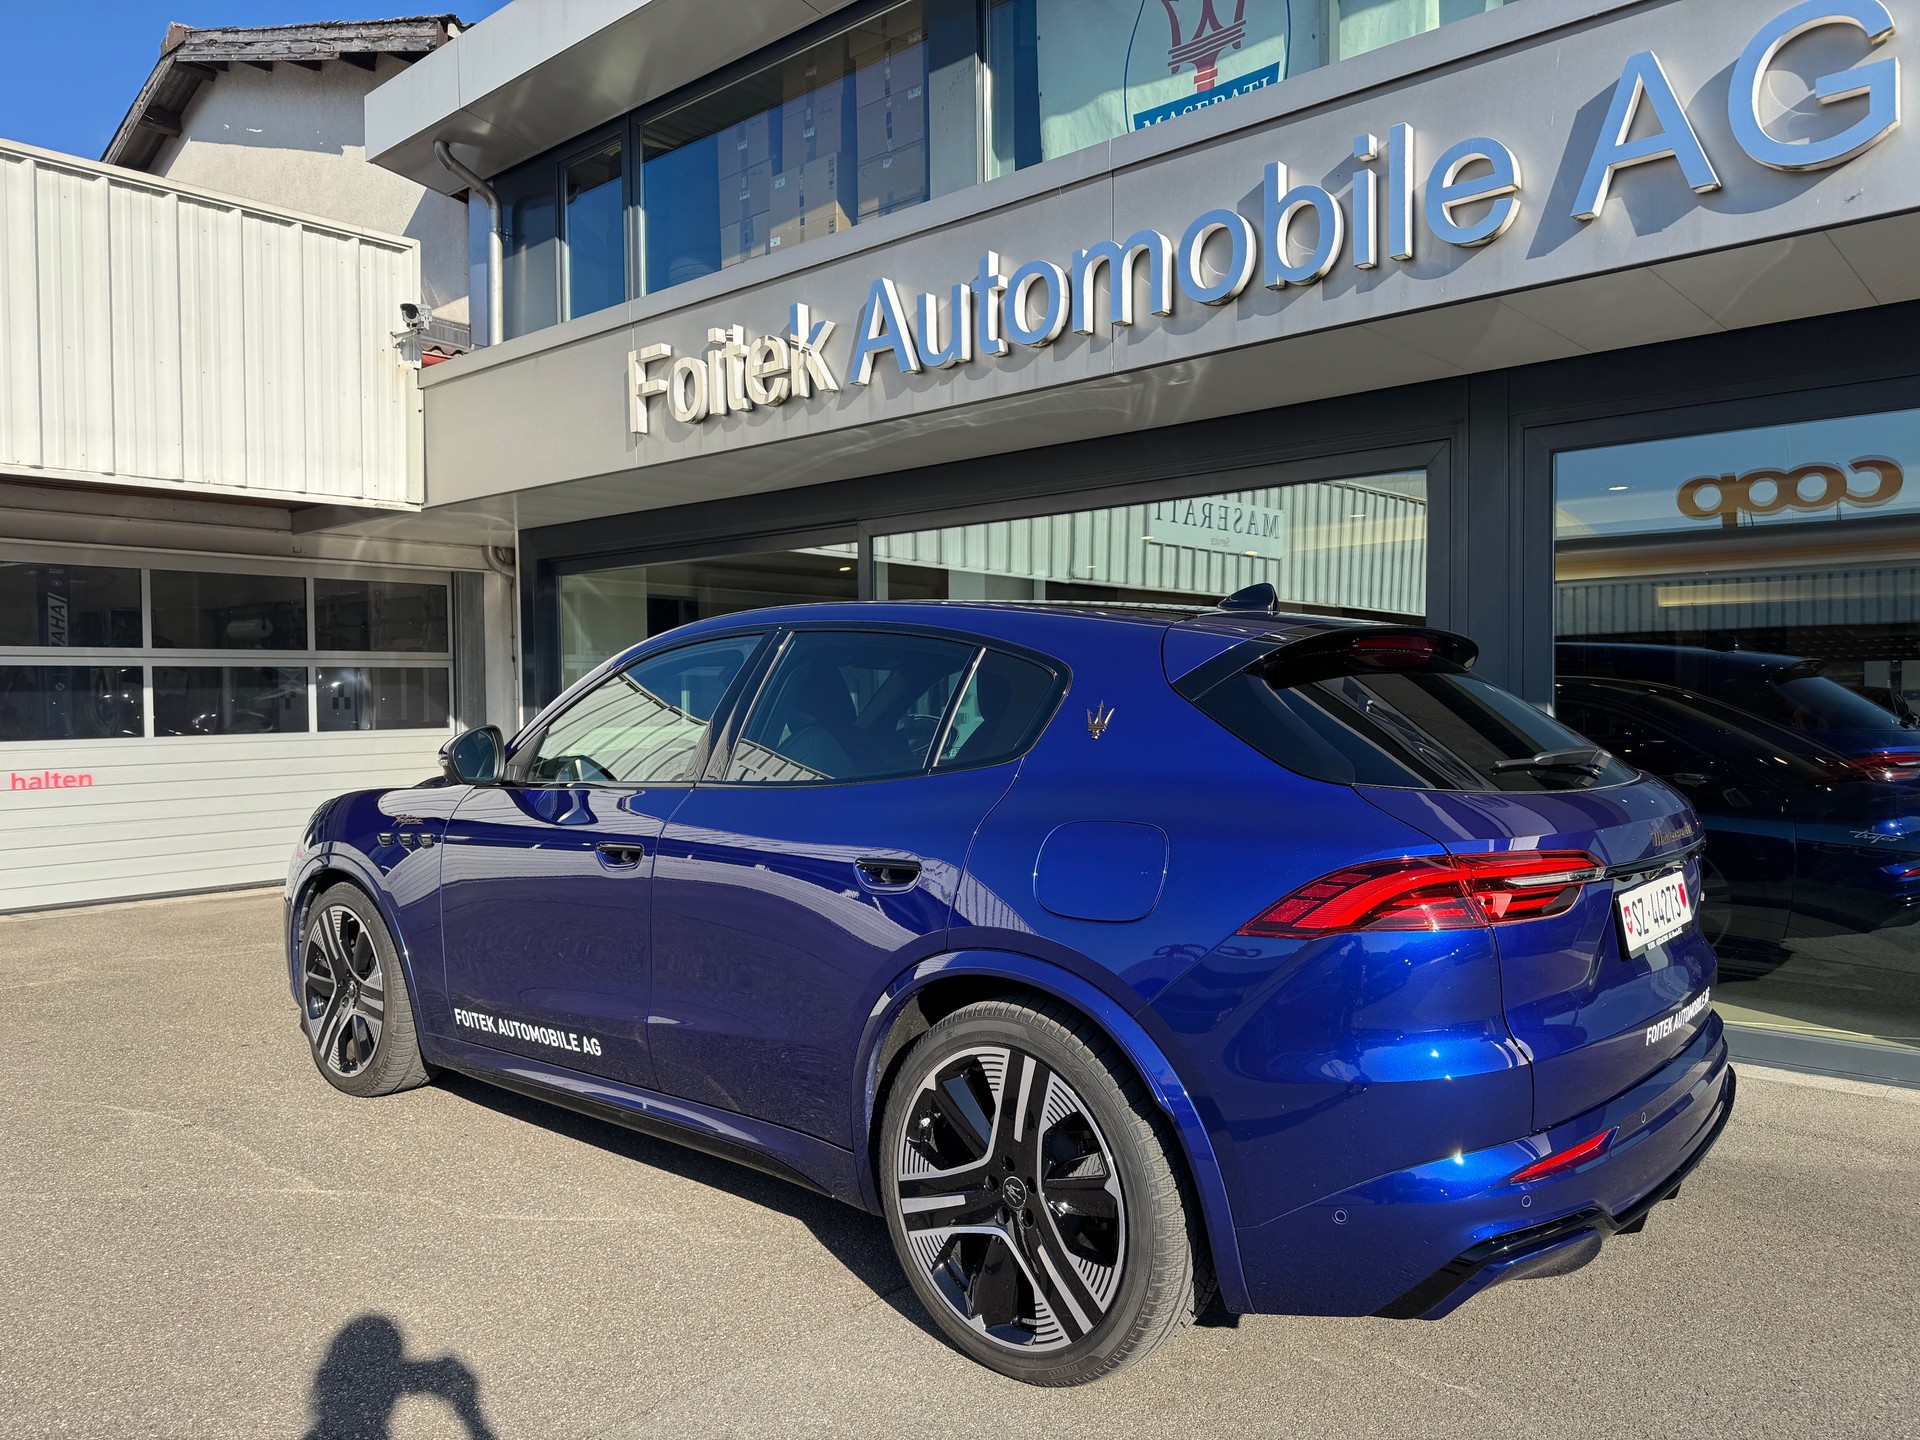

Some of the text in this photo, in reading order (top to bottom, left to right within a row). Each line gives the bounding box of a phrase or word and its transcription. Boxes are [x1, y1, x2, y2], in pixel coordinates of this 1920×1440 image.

[628, 0, 1901, 434] Foitek Automobile AG
[11, 771, 93, 791] halten
[454, 1008, 602, 1056] FOITEK AUTOMOBILE AG
[1645, 1015, 1674, 1046] FOITEK
